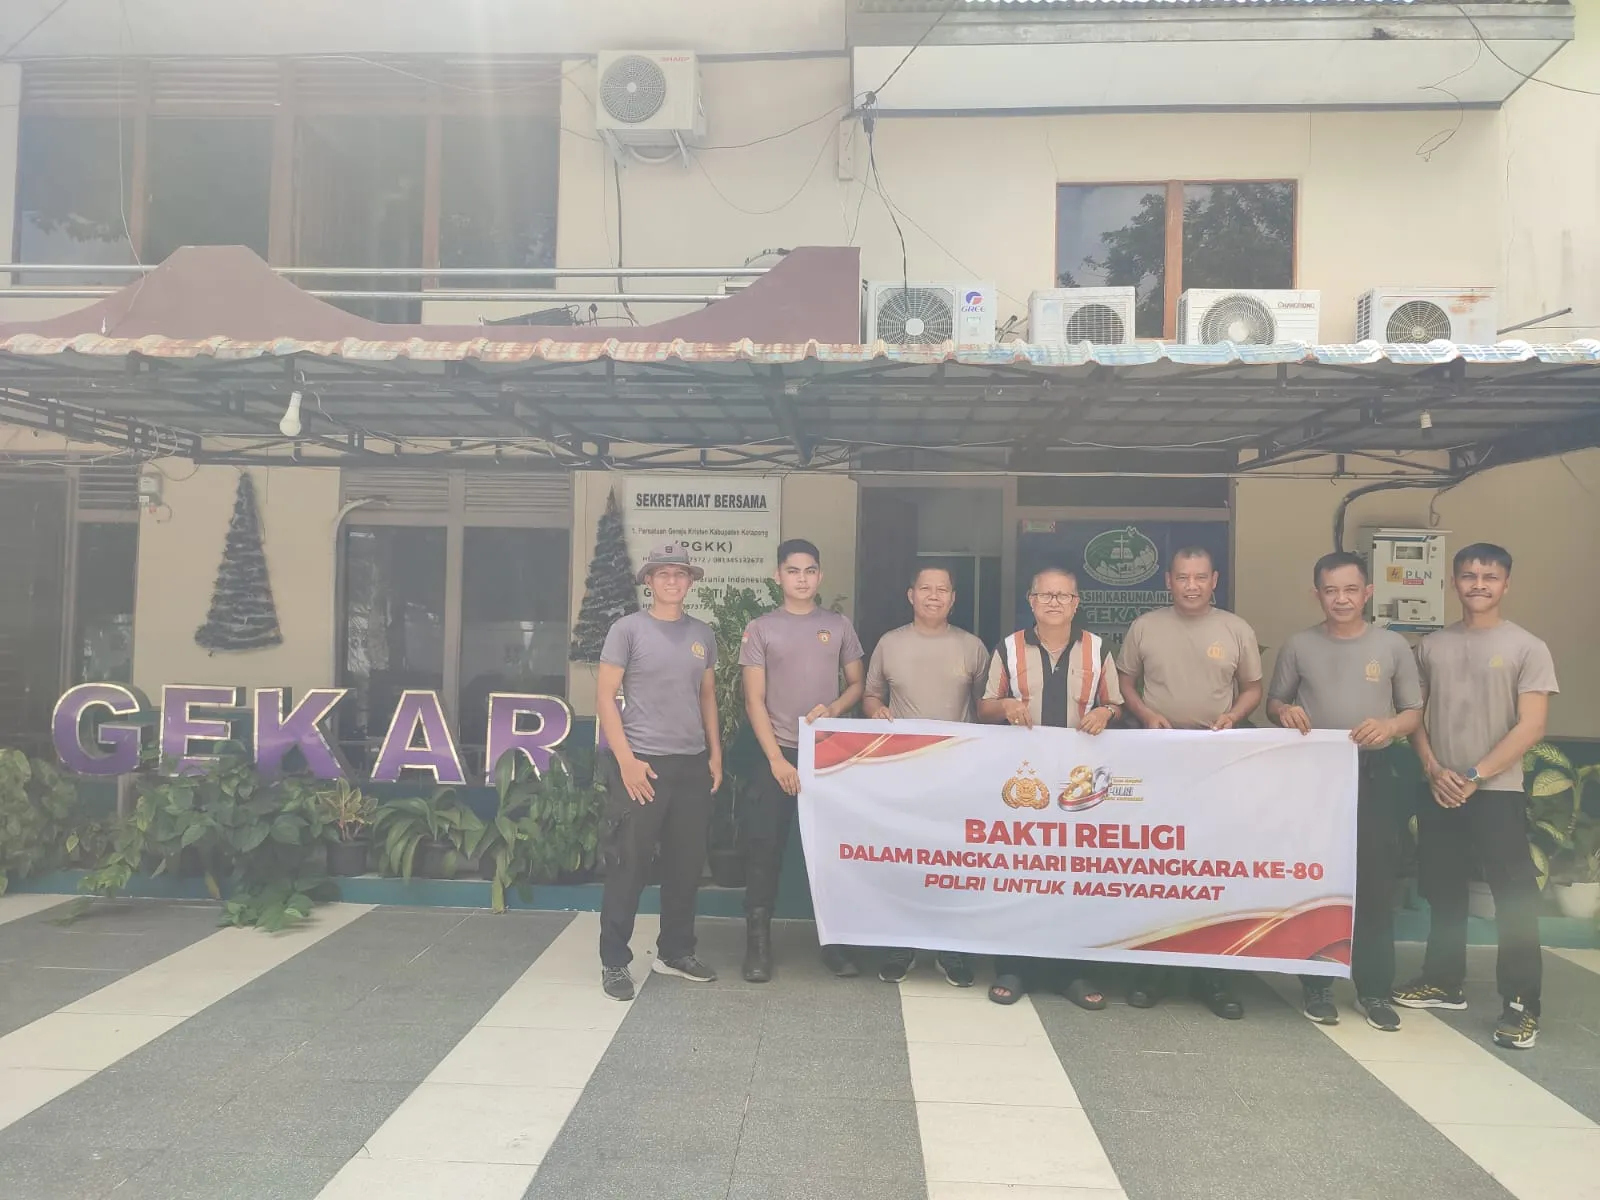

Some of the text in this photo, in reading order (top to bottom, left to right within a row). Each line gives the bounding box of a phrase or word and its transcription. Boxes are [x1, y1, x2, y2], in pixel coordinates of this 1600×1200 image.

[961, 305, 985, 313] GREE
[636, 492, 767, 508] SEKRETARIAT BERSAMA
[675, 540, 733, 553] PGKK)
[1406, 570, 1432, 579] PLN
[965, 819, 1185, 850] BAKTI RELIGI
[839, 843, 1324, 880] DALAM RANGKA HARI BHAYANGKARA KE-80
[924, 873, 1226, 900] POLRI UNTUK MASYARAKAT
